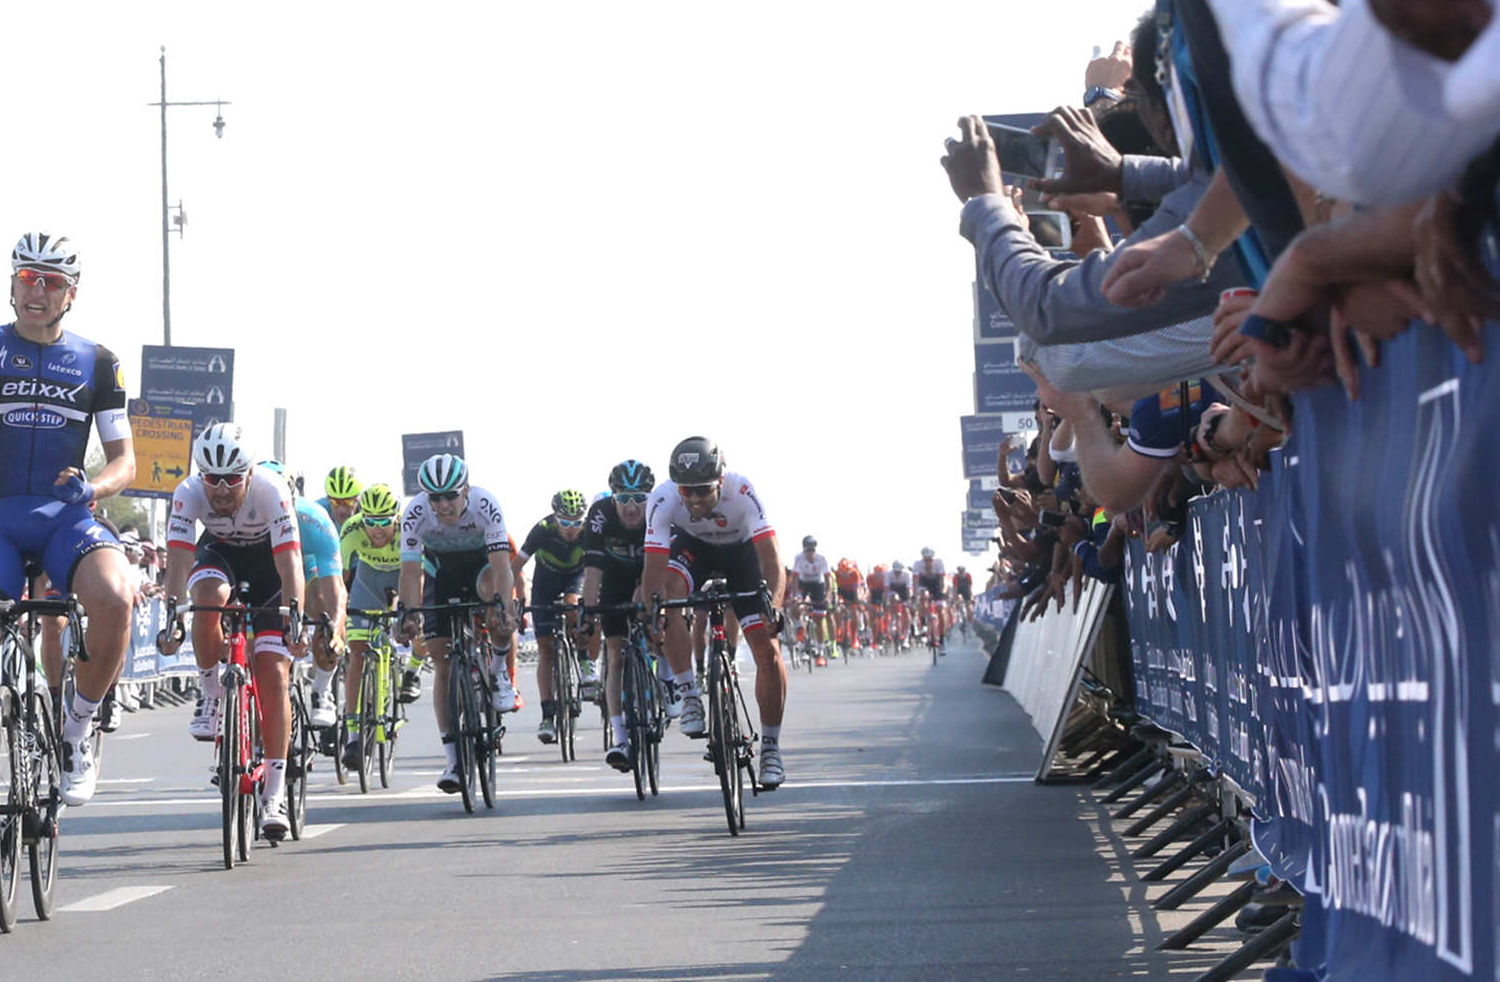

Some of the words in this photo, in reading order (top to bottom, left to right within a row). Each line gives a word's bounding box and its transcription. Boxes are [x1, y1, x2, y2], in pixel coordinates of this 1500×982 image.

[48, 362, 82, 376] latexco
[1, 379, 74, 398] etixx
[1018, 418, 1033, 428] 50
[136, 429, 184, 440] CROSSING
